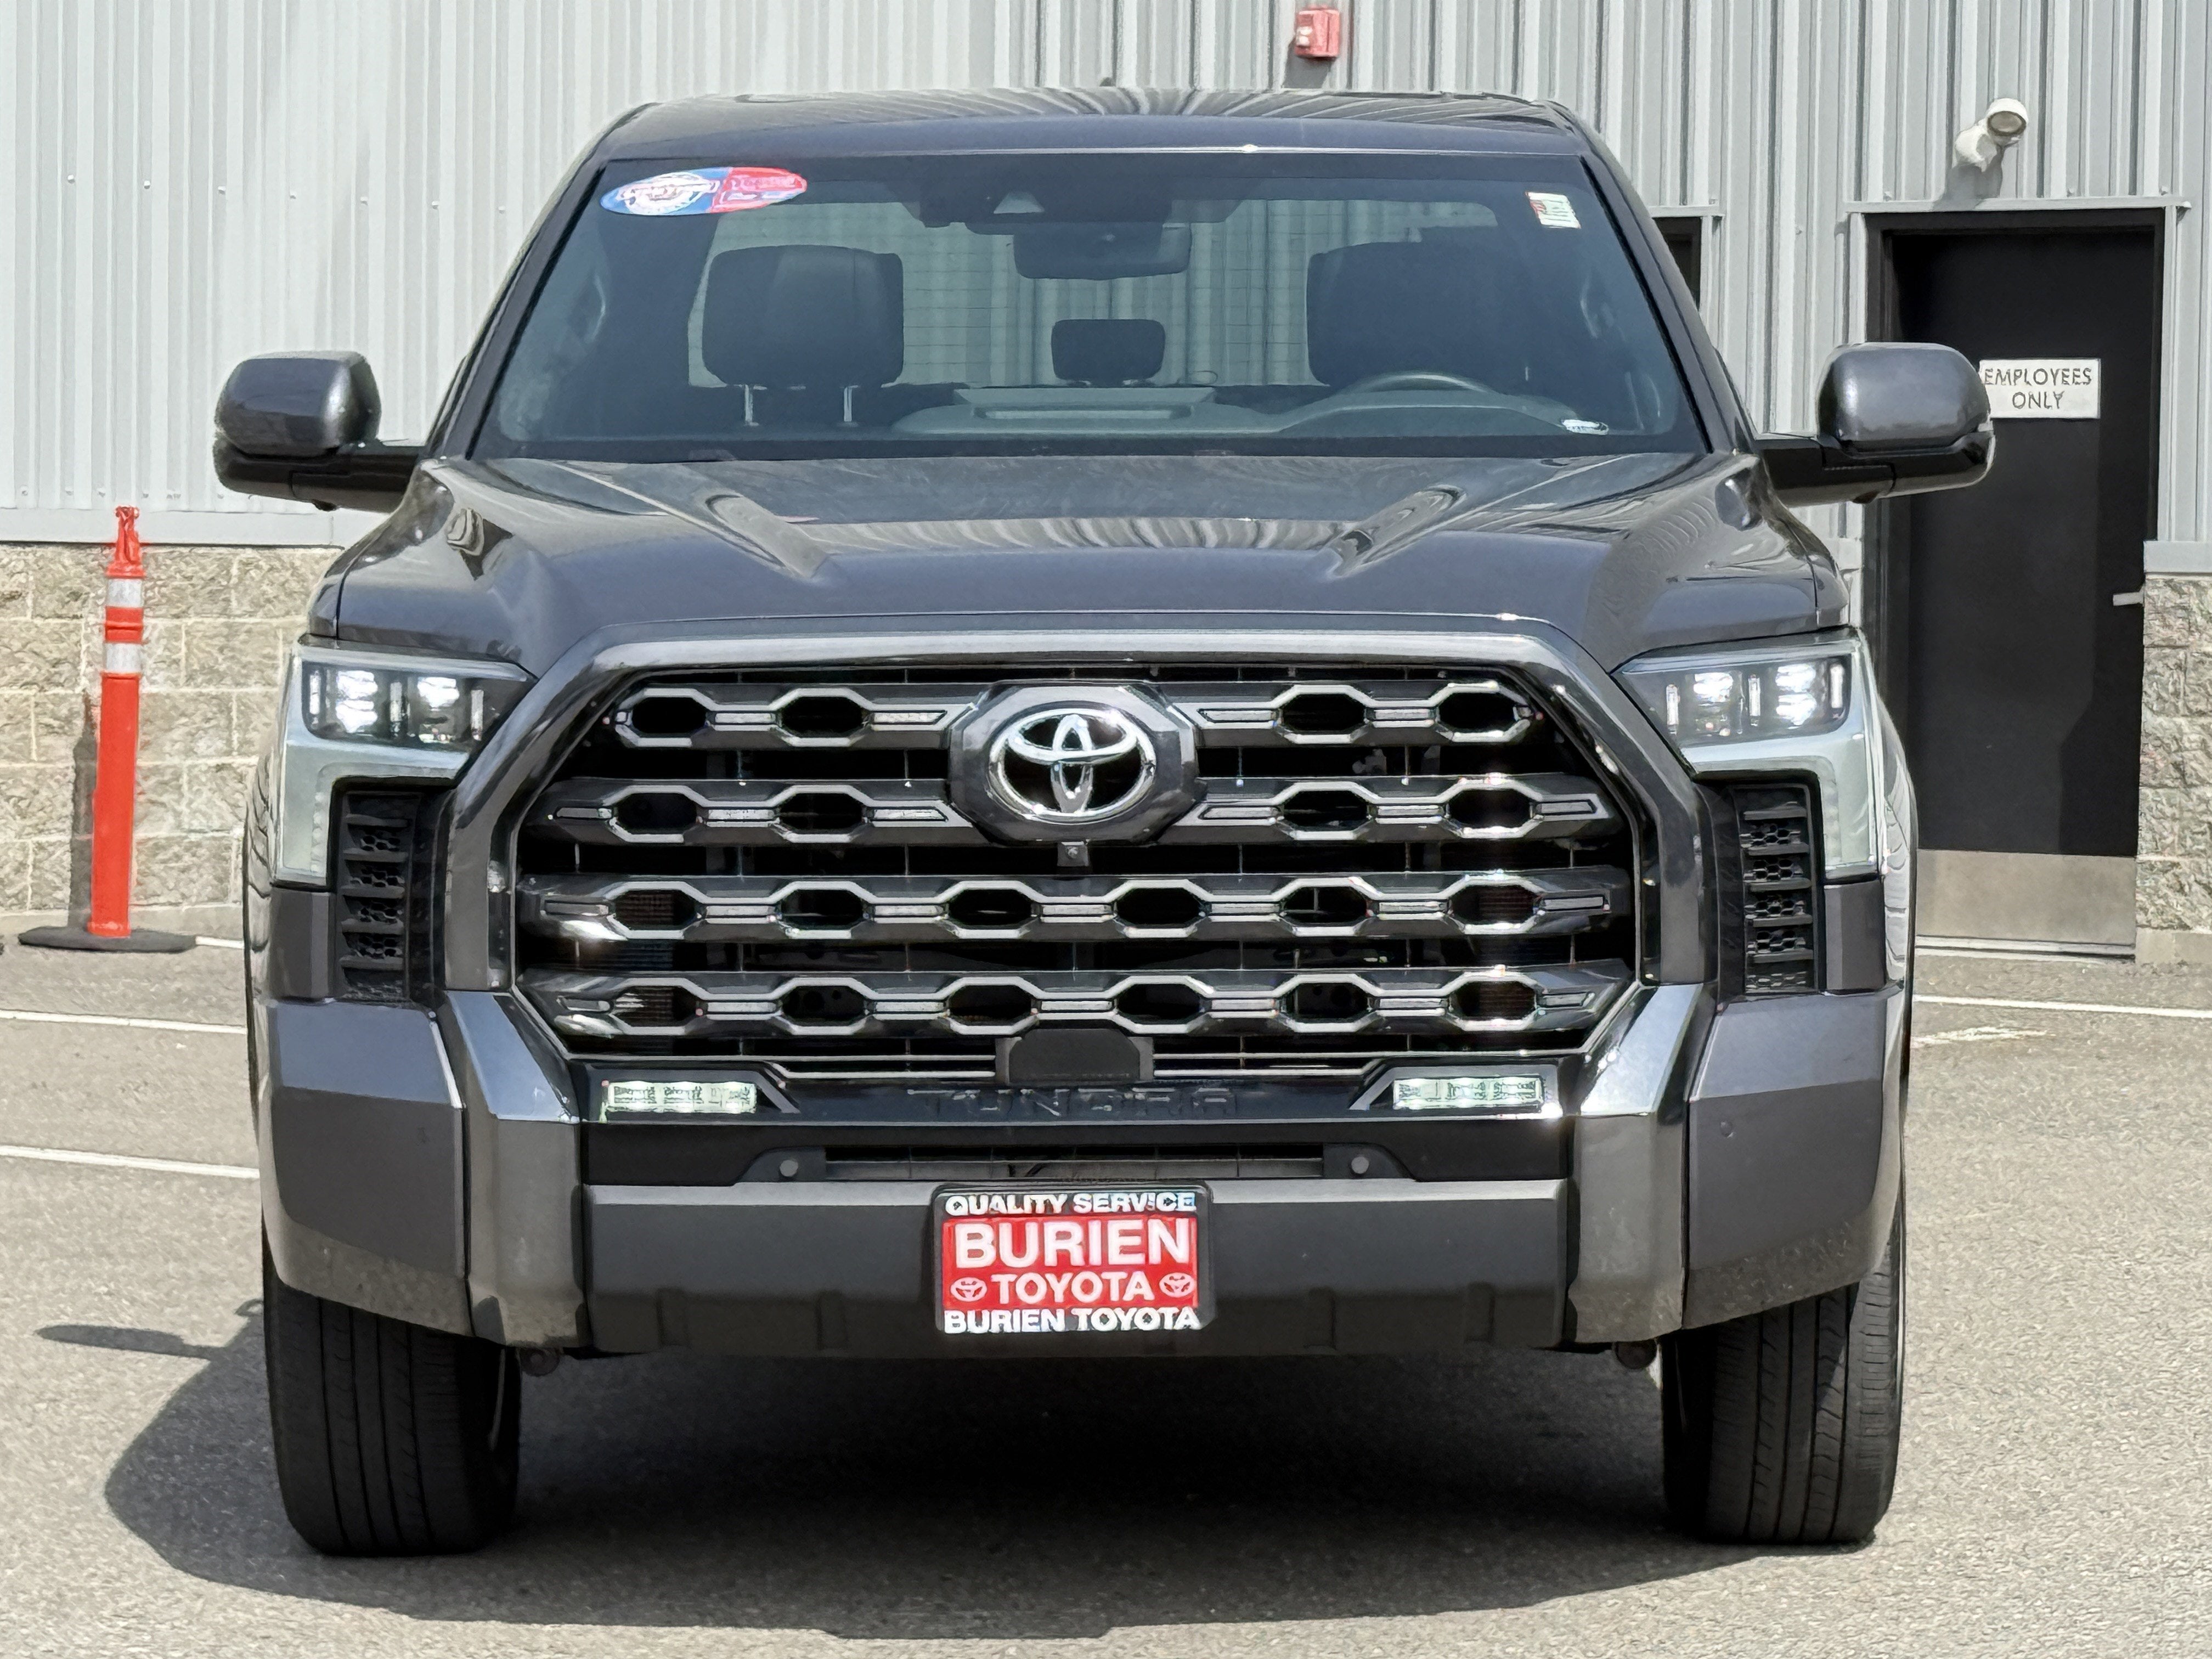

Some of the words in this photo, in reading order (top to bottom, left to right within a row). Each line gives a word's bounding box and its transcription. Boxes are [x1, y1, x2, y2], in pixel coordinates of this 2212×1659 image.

[1984, 368, 2092, 386] EMPLOYEES
[2012, 391, 2064, 409] ONLY
[945, 1193, 1068, 1216] QUALITY
[1073, 1192, 1197, 1214] SERVICE
[955, 1217, 1190, 1268] BURIEN
[991, 1271, 1155, 1304] TOYOTA
[944, 1308, 1066, 1334] BURIEN
[1071, 1306, 1203, 1331] TOYOTA
